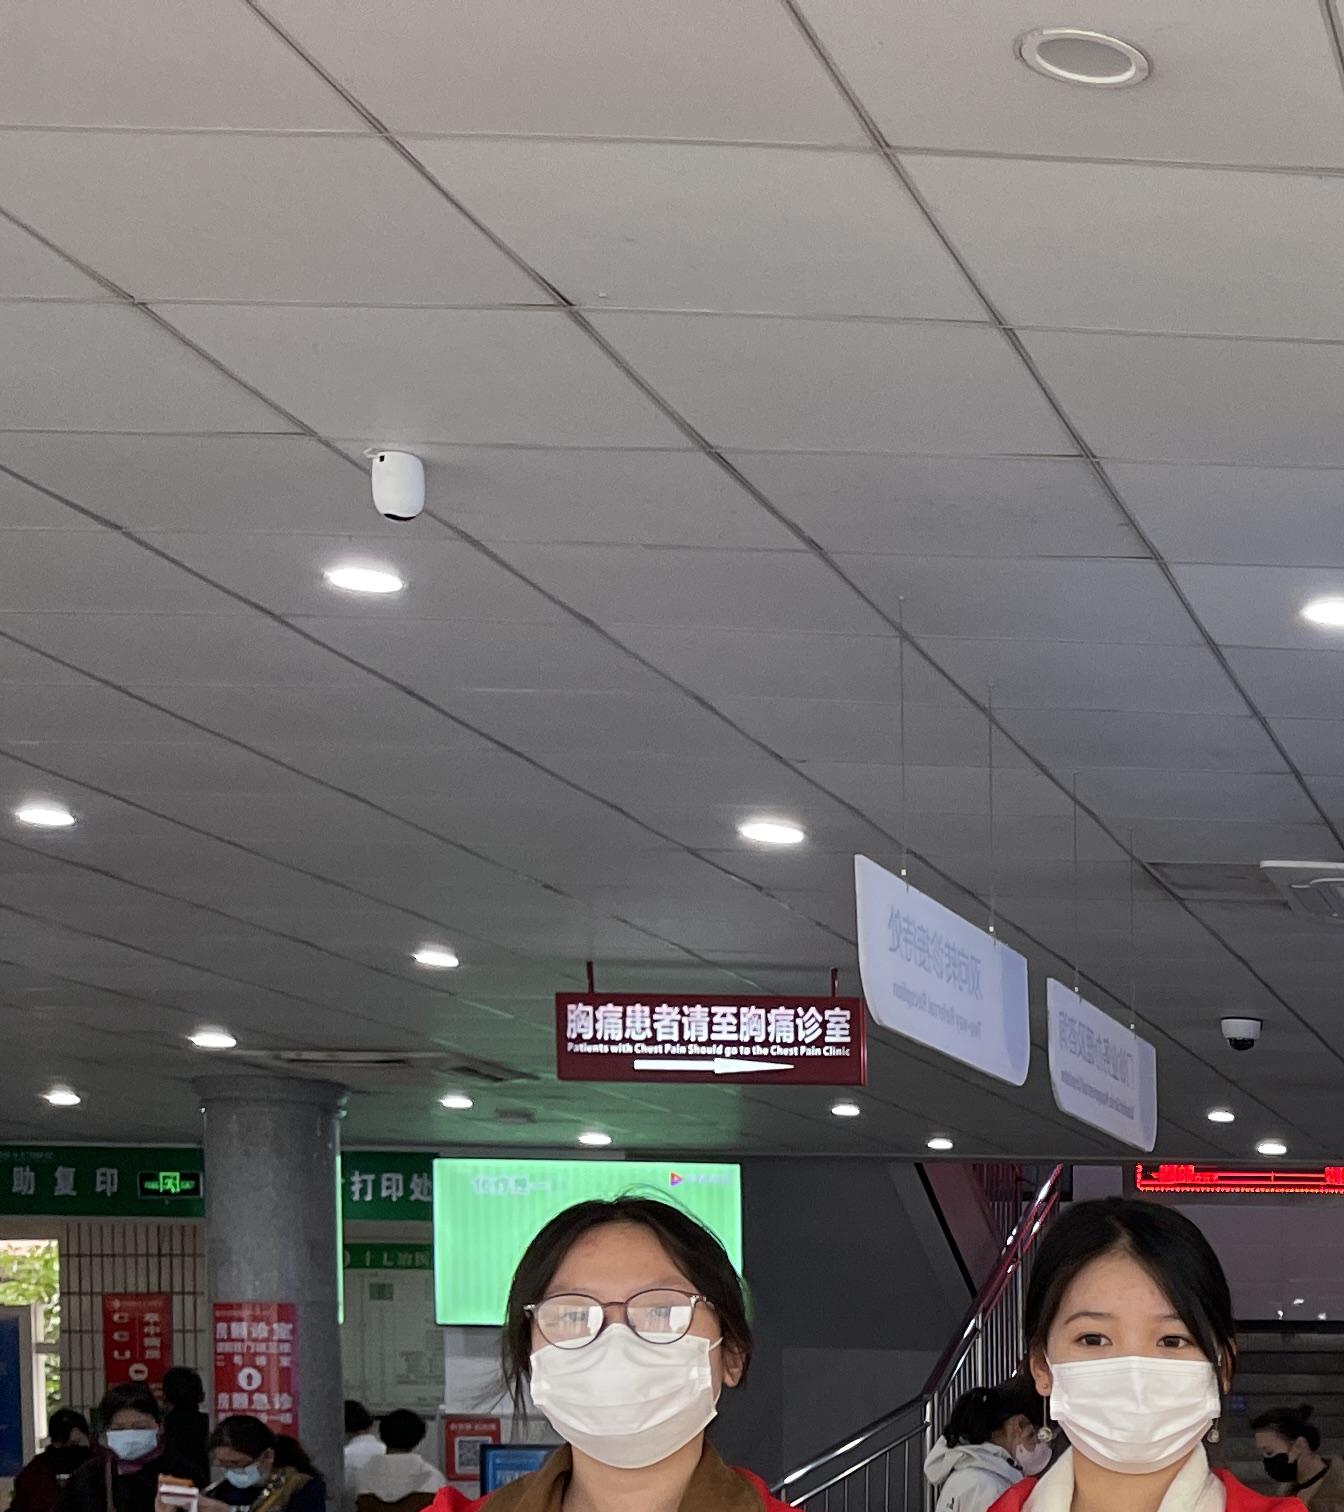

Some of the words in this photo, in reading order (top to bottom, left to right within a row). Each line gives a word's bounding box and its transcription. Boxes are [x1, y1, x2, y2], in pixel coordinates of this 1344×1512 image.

[566, 1002, 851, 1044] 胸痛患者请至胸痛诊室
[567, 1041, 609, 1053] Patients
[610, 1042, 632, 1054] with
[634, 1043, 662, 1054] Chest
[664, 1044, 686, 1055] Pain
[687, 1044, 723, 1056] Should
[724, 1047, 739, 1058] go
[740, 1046, 751, 1056] to
[752, 1045, 768, 1056] the
[770, 1045, 798, 1057] Chest
[800, 1046, 821, 1057] Pain
[823, 1046, 850, 1057] Clinic
